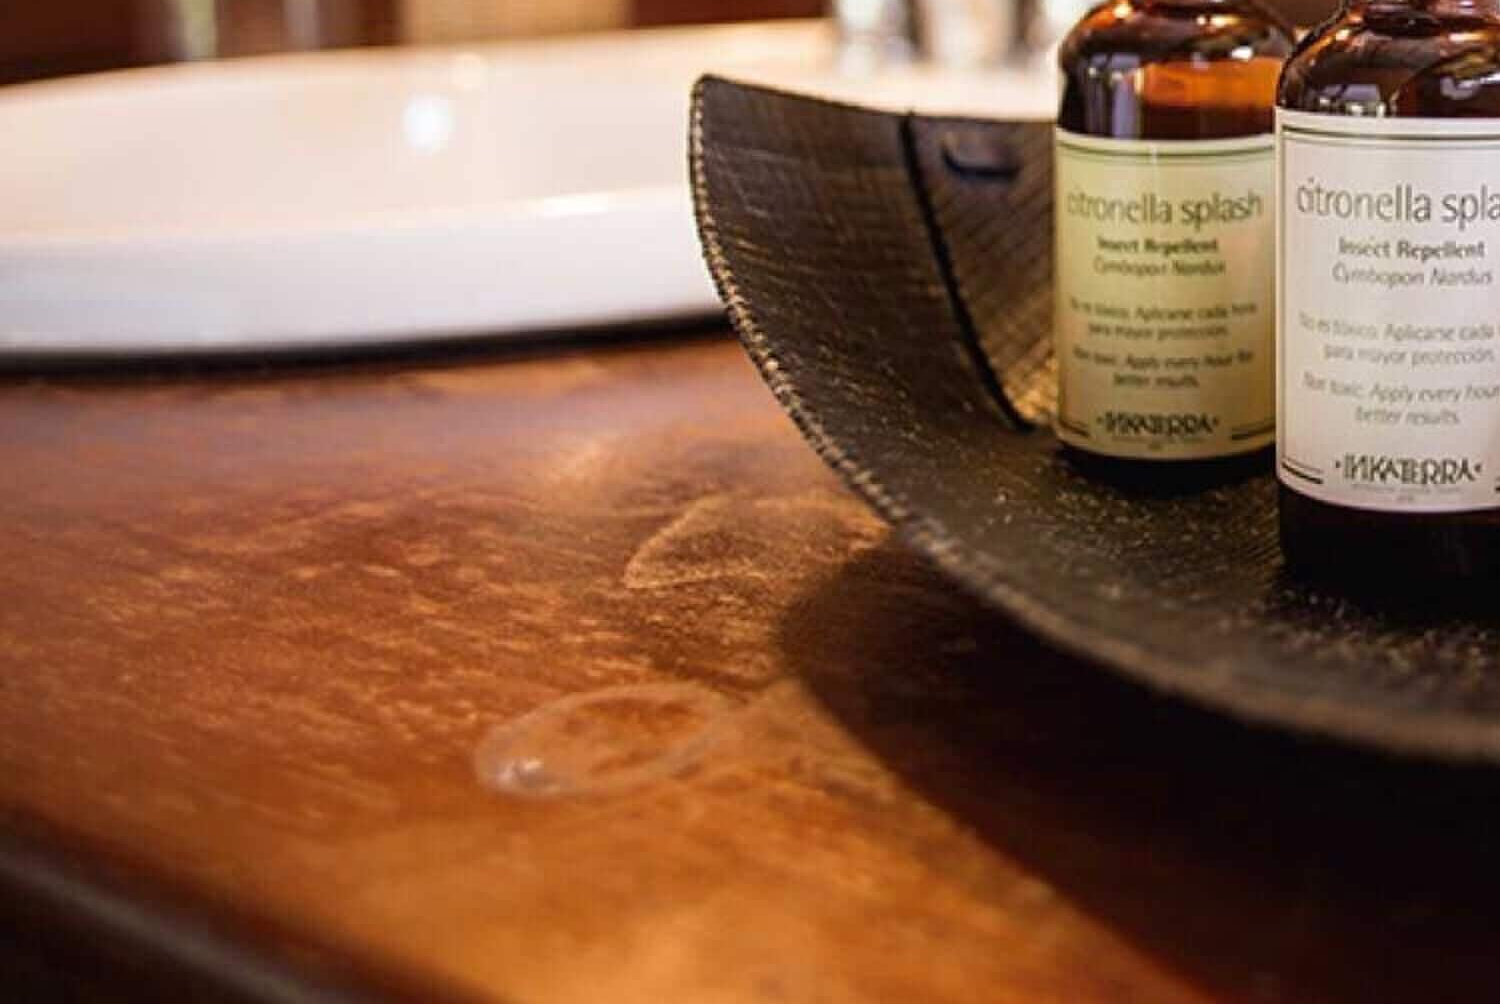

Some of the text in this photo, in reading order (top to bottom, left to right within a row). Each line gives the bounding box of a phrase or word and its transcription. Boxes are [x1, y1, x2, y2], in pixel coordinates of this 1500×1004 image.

[1181, 188, 1262, 231] splash
[1297, 177, 1432, 222] citronella
[1338, 236, 1485, 262] Insect Repellent
[1430, 266, 1493, 285] Nardus
[1344, 453, 1475, 485] INKATERRA
